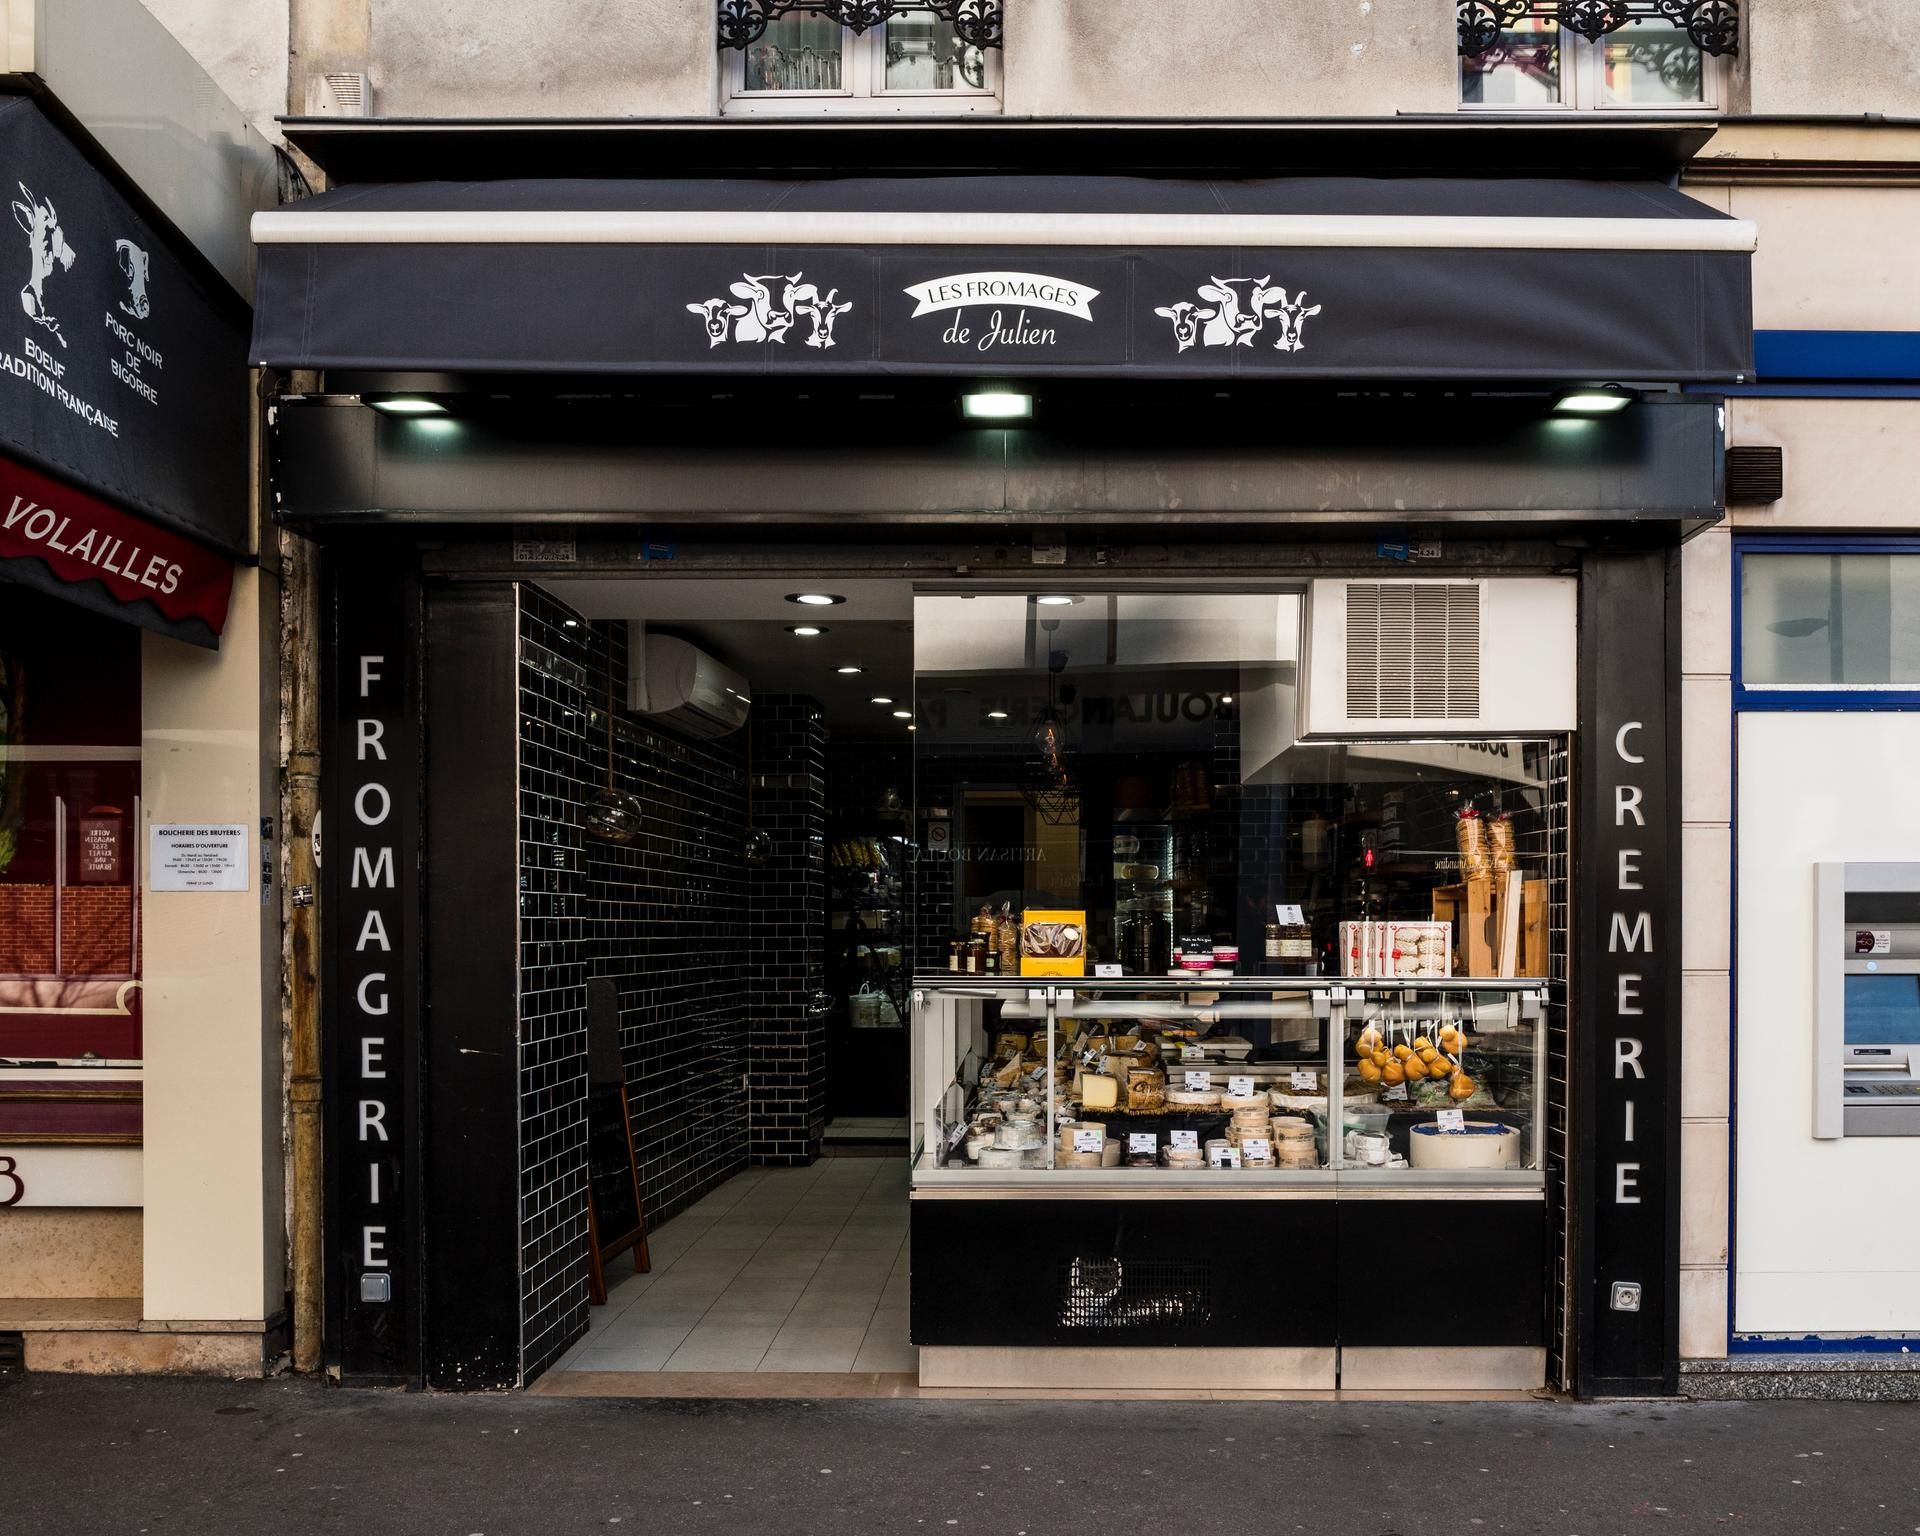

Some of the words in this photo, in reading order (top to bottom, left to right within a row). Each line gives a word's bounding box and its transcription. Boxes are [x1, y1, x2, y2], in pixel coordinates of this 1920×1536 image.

[928, 283, 963, 305] LES
[965, 280, 1078, 307] FROMAGES
[105, 311, 135, 348] PORC
[136, 338, 163, 369] NOIR
[942, 308, 970, 345] de
[977, 309, 1057, 352] Julien
[25, 337, 66, 379] BOEUF
[110, 358, 158, 406] BIGORRE
[126, 350, 141, 374] DE
[57, 383, 119, 439] FRANÇAISE
[2, 495, 184, 594] VOLAILLES
[351, 656, 395, 1267] FROMAGERIE
[1608, 721, 1654, 1204] CREMERIE
